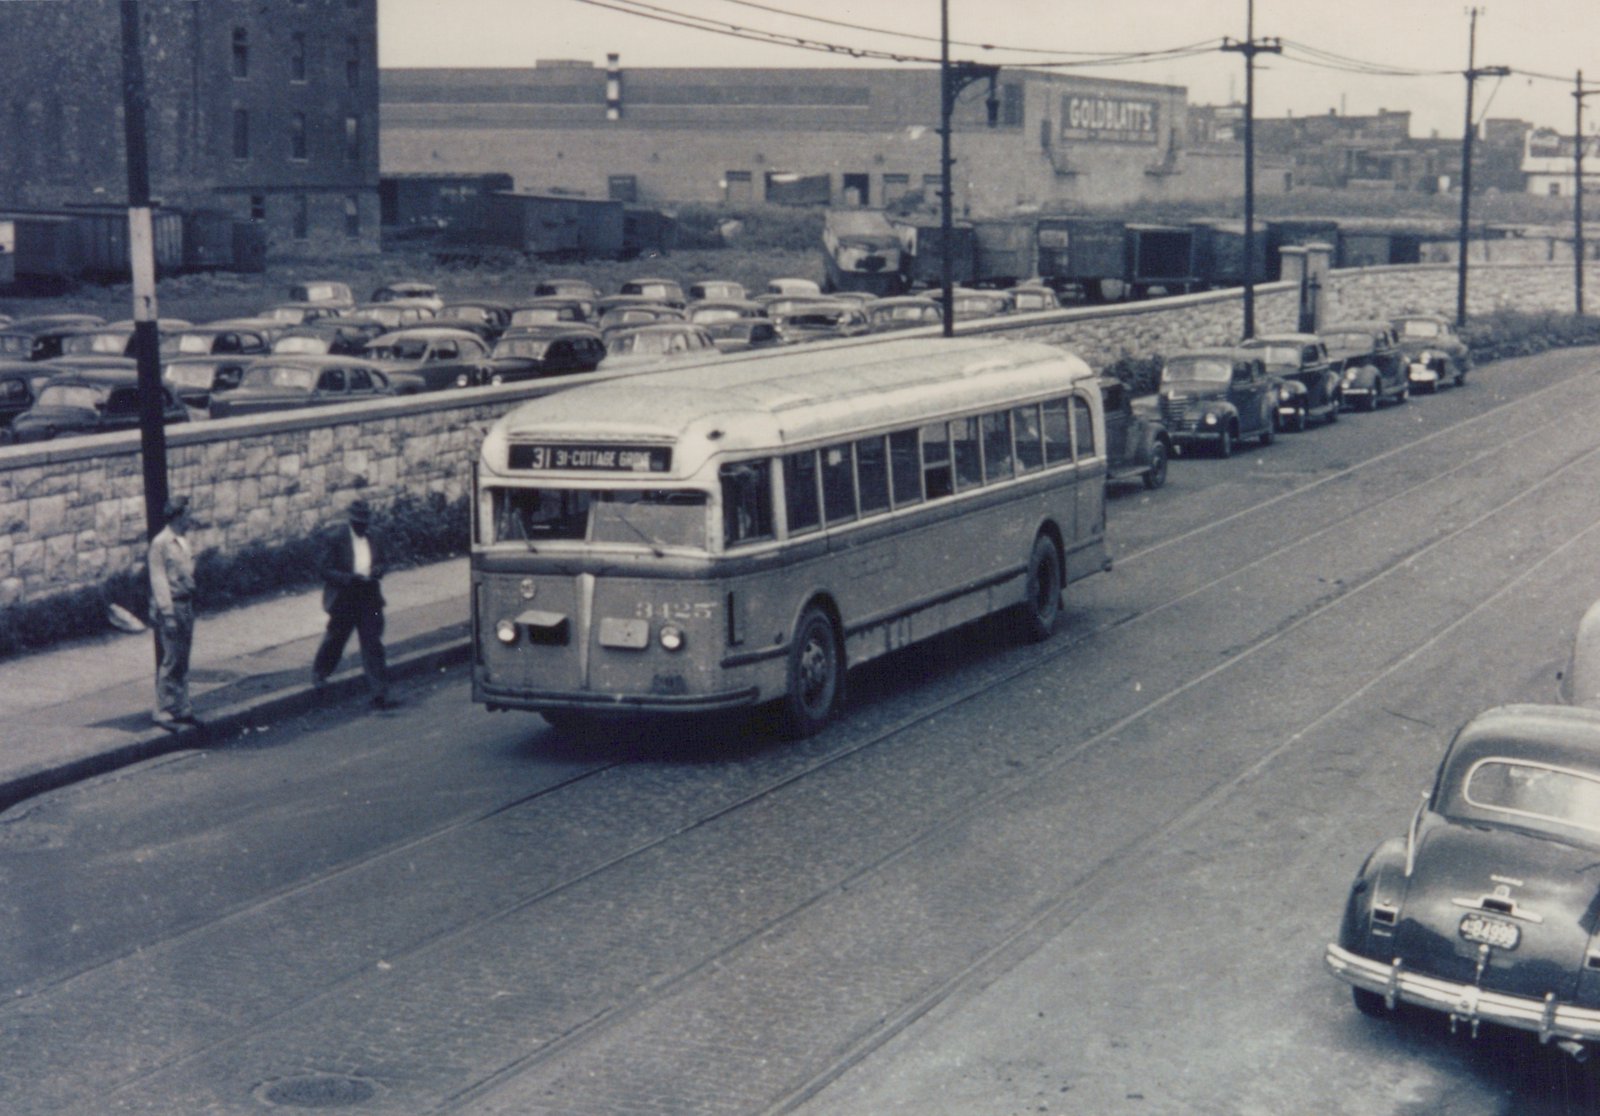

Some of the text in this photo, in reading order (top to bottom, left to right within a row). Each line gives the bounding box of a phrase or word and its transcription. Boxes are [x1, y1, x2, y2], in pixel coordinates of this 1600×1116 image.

[1069, 97, 1152, 131] GOLDBLATT'S
[532, 447, 551, 470] 31
[635, 601, 718, 619] 3425
